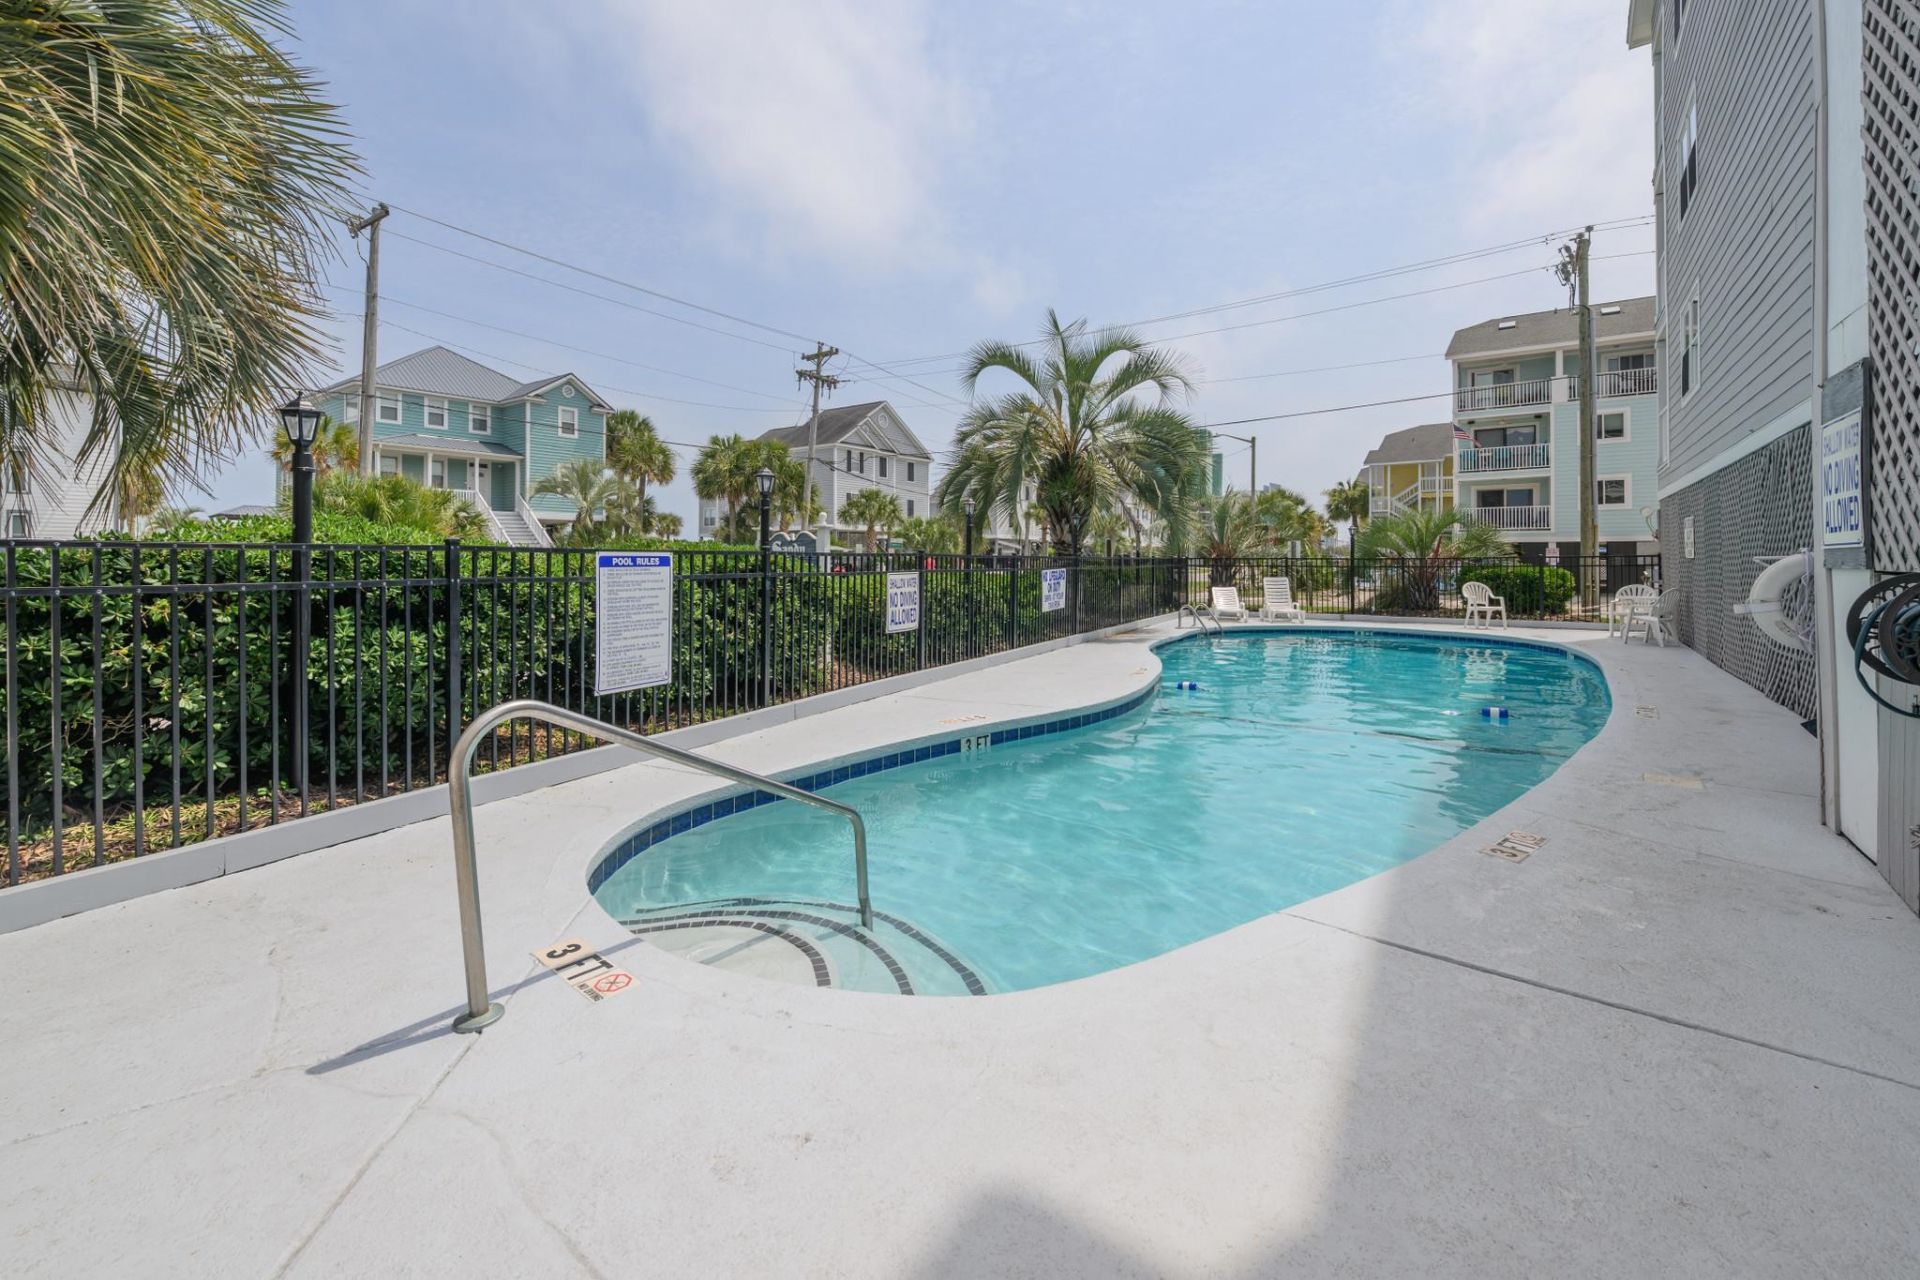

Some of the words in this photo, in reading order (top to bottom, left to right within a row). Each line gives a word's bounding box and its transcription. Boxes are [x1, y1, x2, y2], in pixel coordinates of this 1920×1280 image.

[1823, 430, 1842, 457] SHALLOW
[1844, 422, 1860, 449] WATER
[1823, 461, 1833, 497] NO
[1834, 453, 1859, 495] DIVING
[1825, 495, 1860, 534] ALLOWED
[612, 557, 633, 566] POOL
[636, 557, 660, 566] RULES
[889, 592, 898, 608] NO
[899, 591, 917, 607] DIVING
[890, 608, 916, 625] ALLOWED
